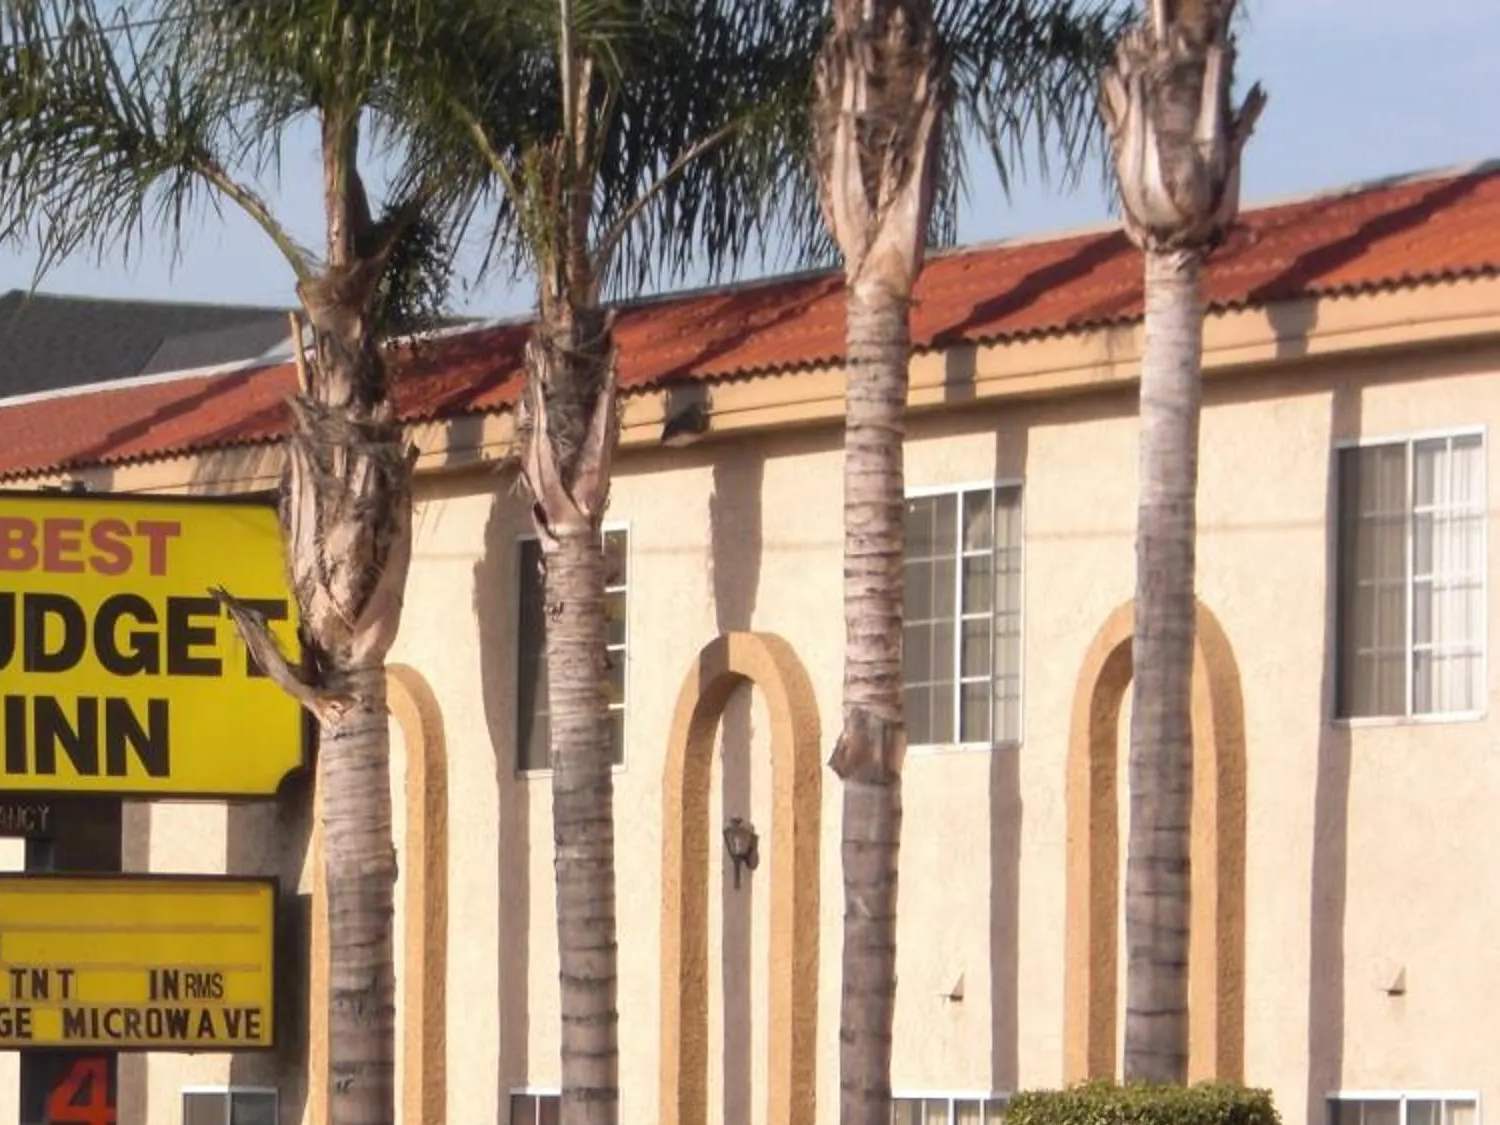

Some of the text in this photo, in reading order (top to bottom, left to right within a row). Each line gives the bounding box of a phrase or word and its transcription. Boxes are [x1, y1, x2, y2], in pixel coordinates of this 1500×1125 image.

[3, 695, 171, 778] INN
[9, 968, 75, 999] TNT
[149, 969, 179, 1000] IN
[184, 972, 224, 1000] RMS
[62, 1007, 262, 1040] MICROWAVE
